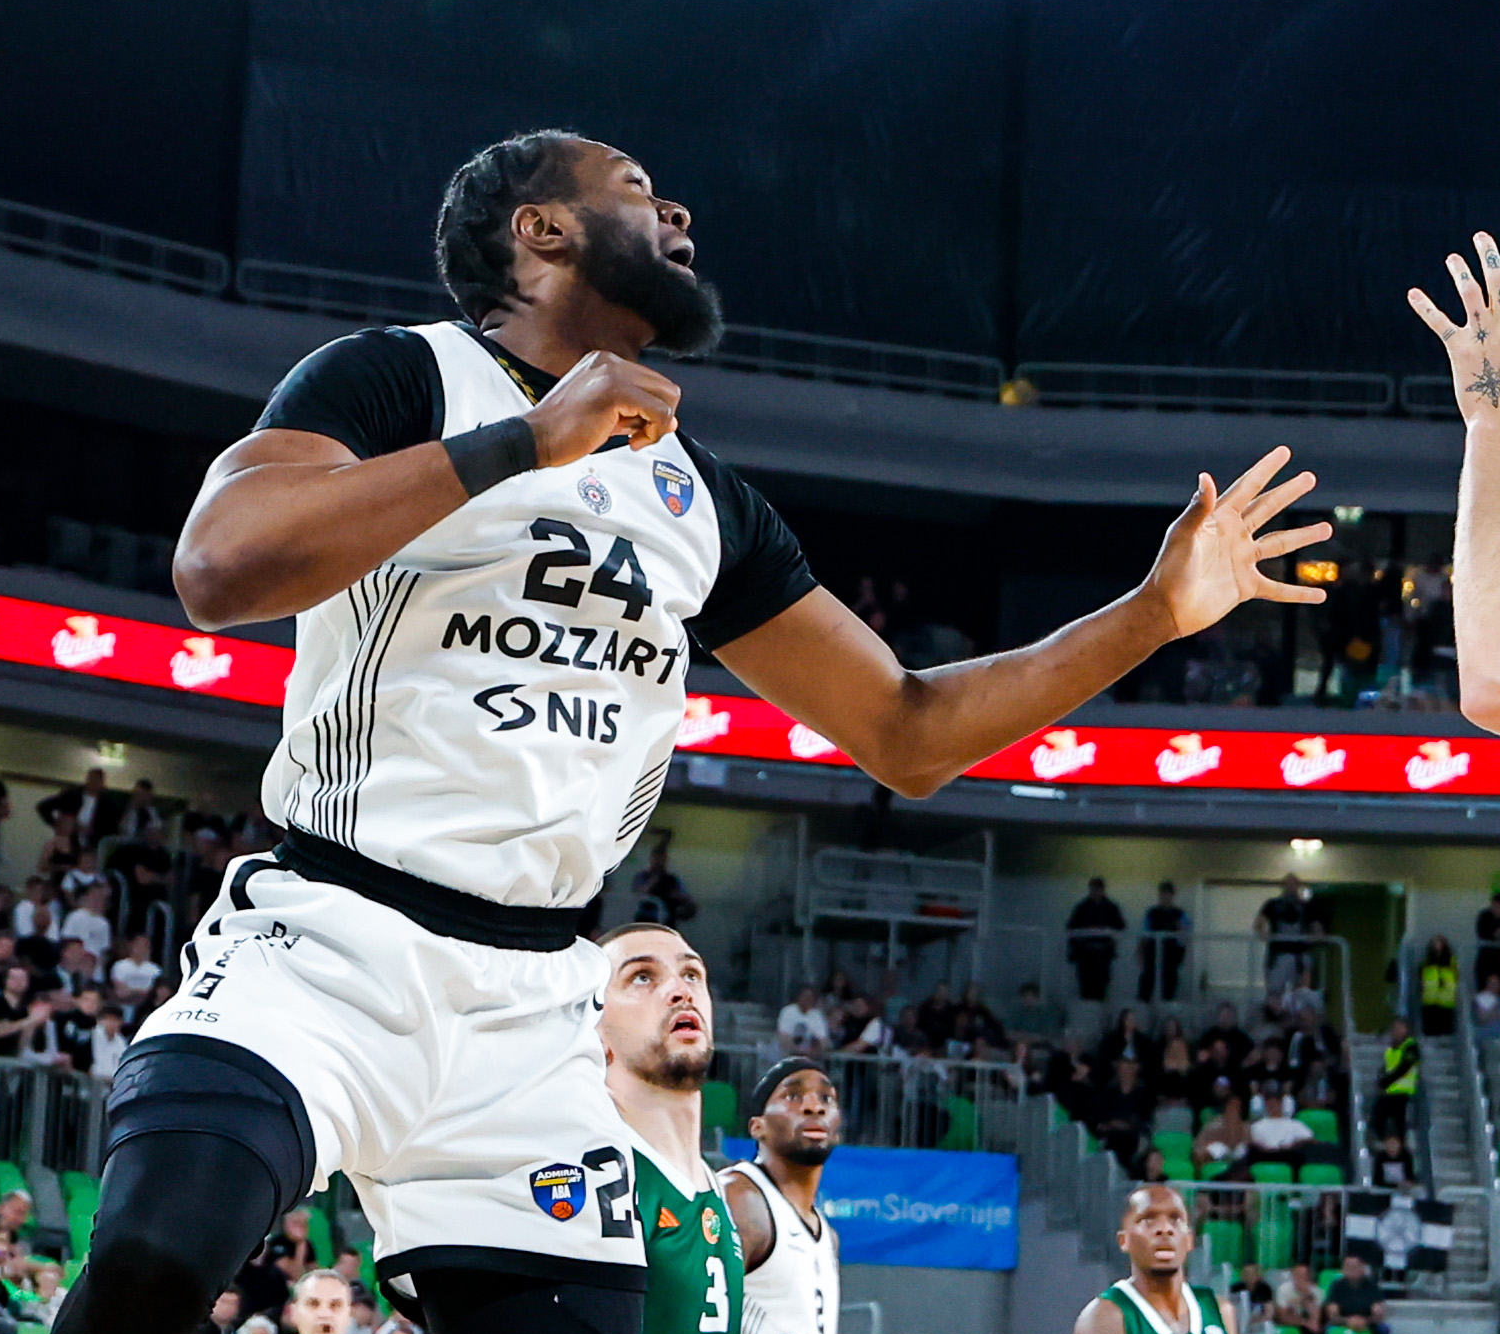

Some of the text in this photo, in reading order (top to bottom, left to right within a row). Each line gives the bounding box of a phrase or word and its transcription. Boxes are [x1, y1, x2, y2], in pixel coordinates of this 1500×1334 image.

[522, 518, 653, 622] 24
[441, 612, 681, 686] MOZZART
[547, 697, 621, 745] NIS
[535, 1167, 582, 1181] ADMIRAL
[551, 1184, 571, 1200] ABA
[581, 1145, 636, 1239] 2
[698, 1256, 730, 1334] 3
